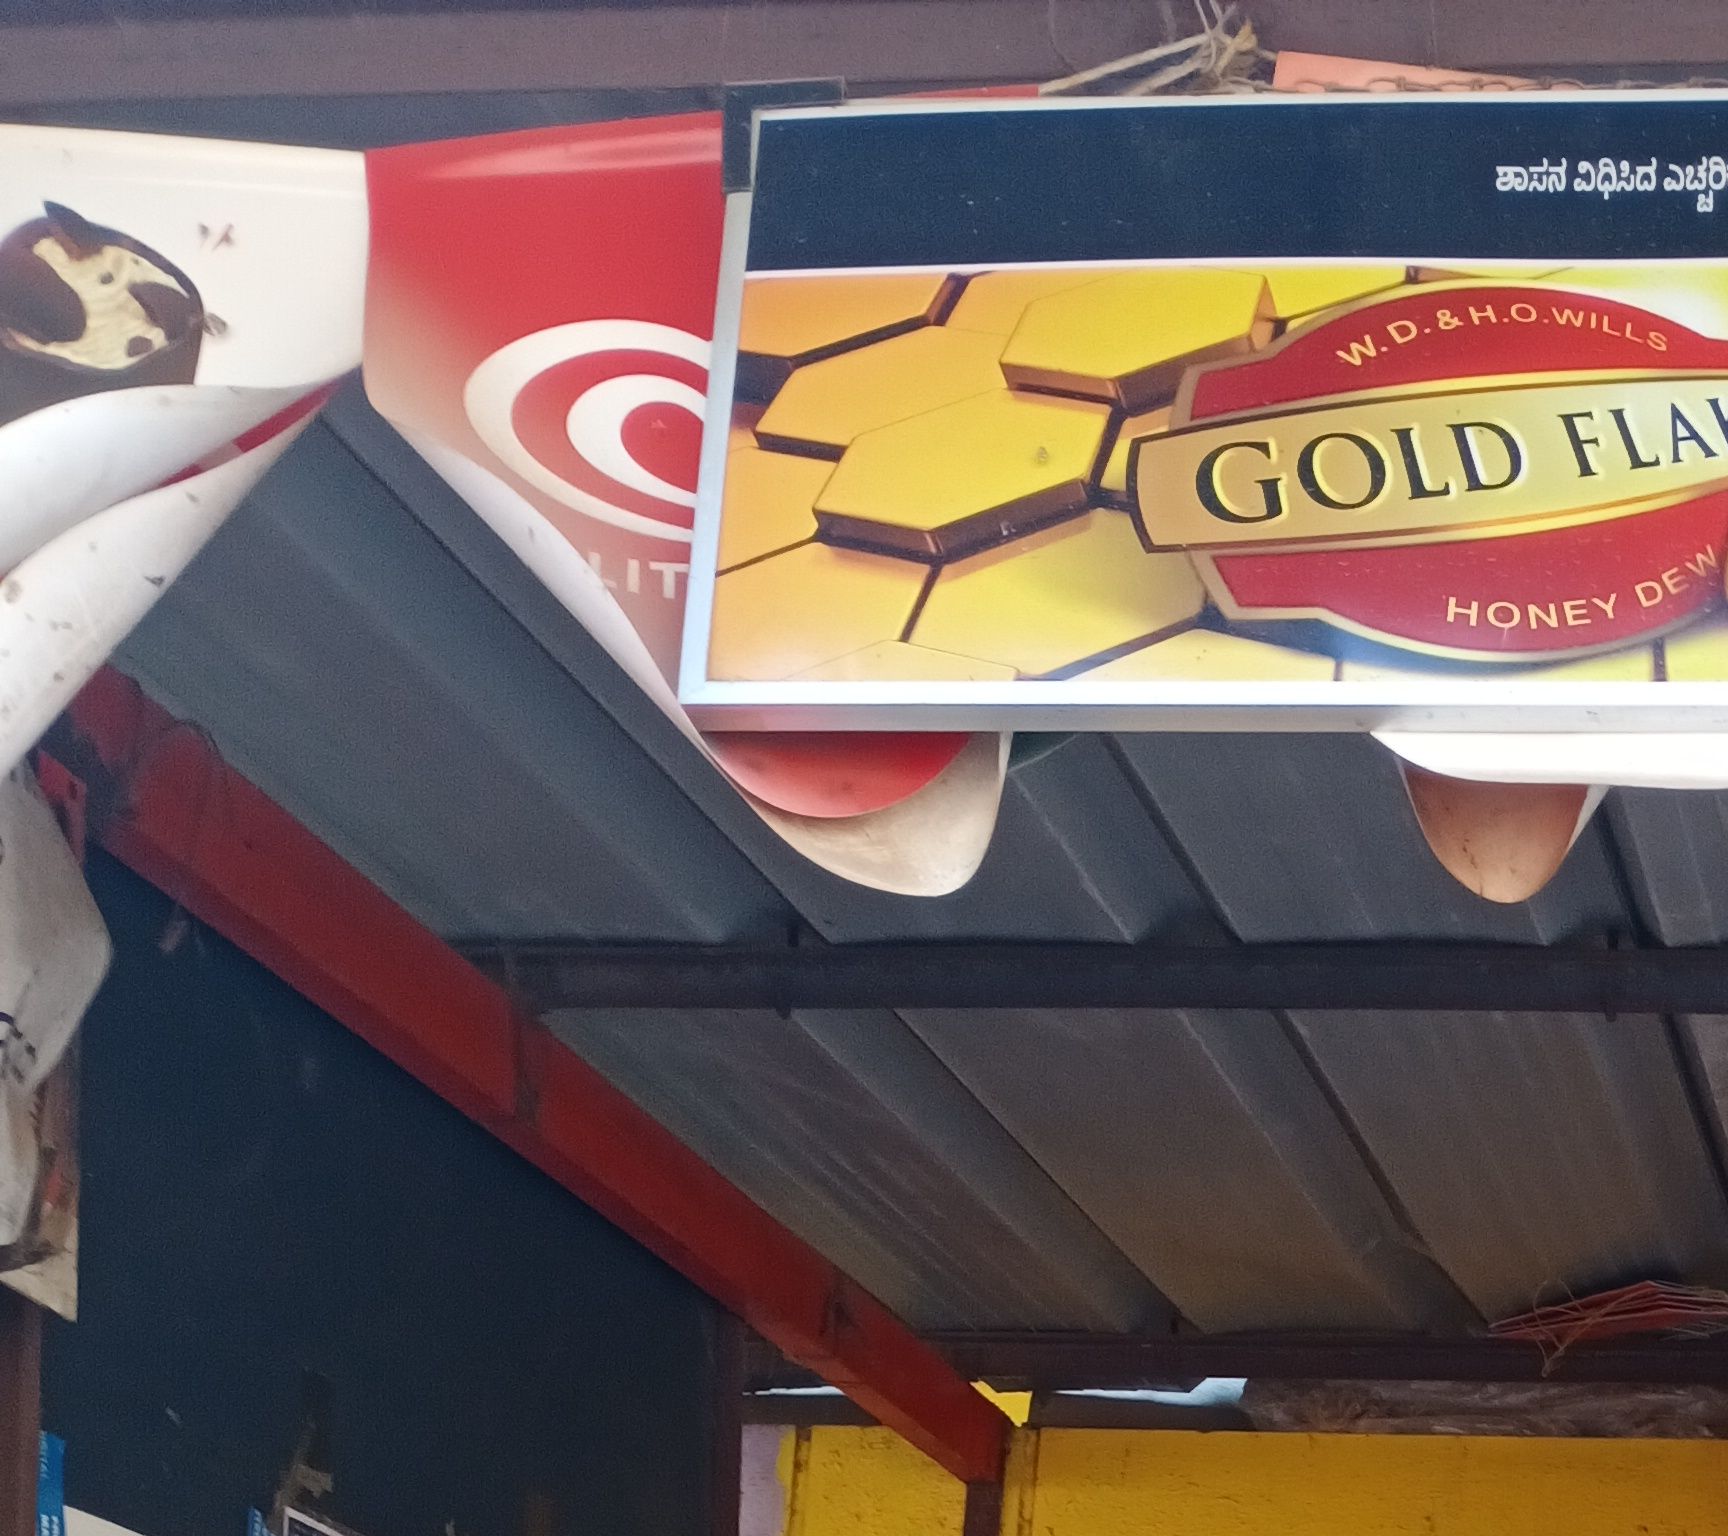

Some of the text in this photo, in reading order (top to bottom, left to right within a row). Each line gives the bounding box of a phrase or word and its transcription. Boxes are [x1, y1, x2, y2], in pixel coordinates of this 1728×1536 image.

[1495, 160, 1569, 193] ಶಾಸನ
[1194, 420, 1524, 524] GOLD
[1445, 544, 1720, 631] HONEY DEW
